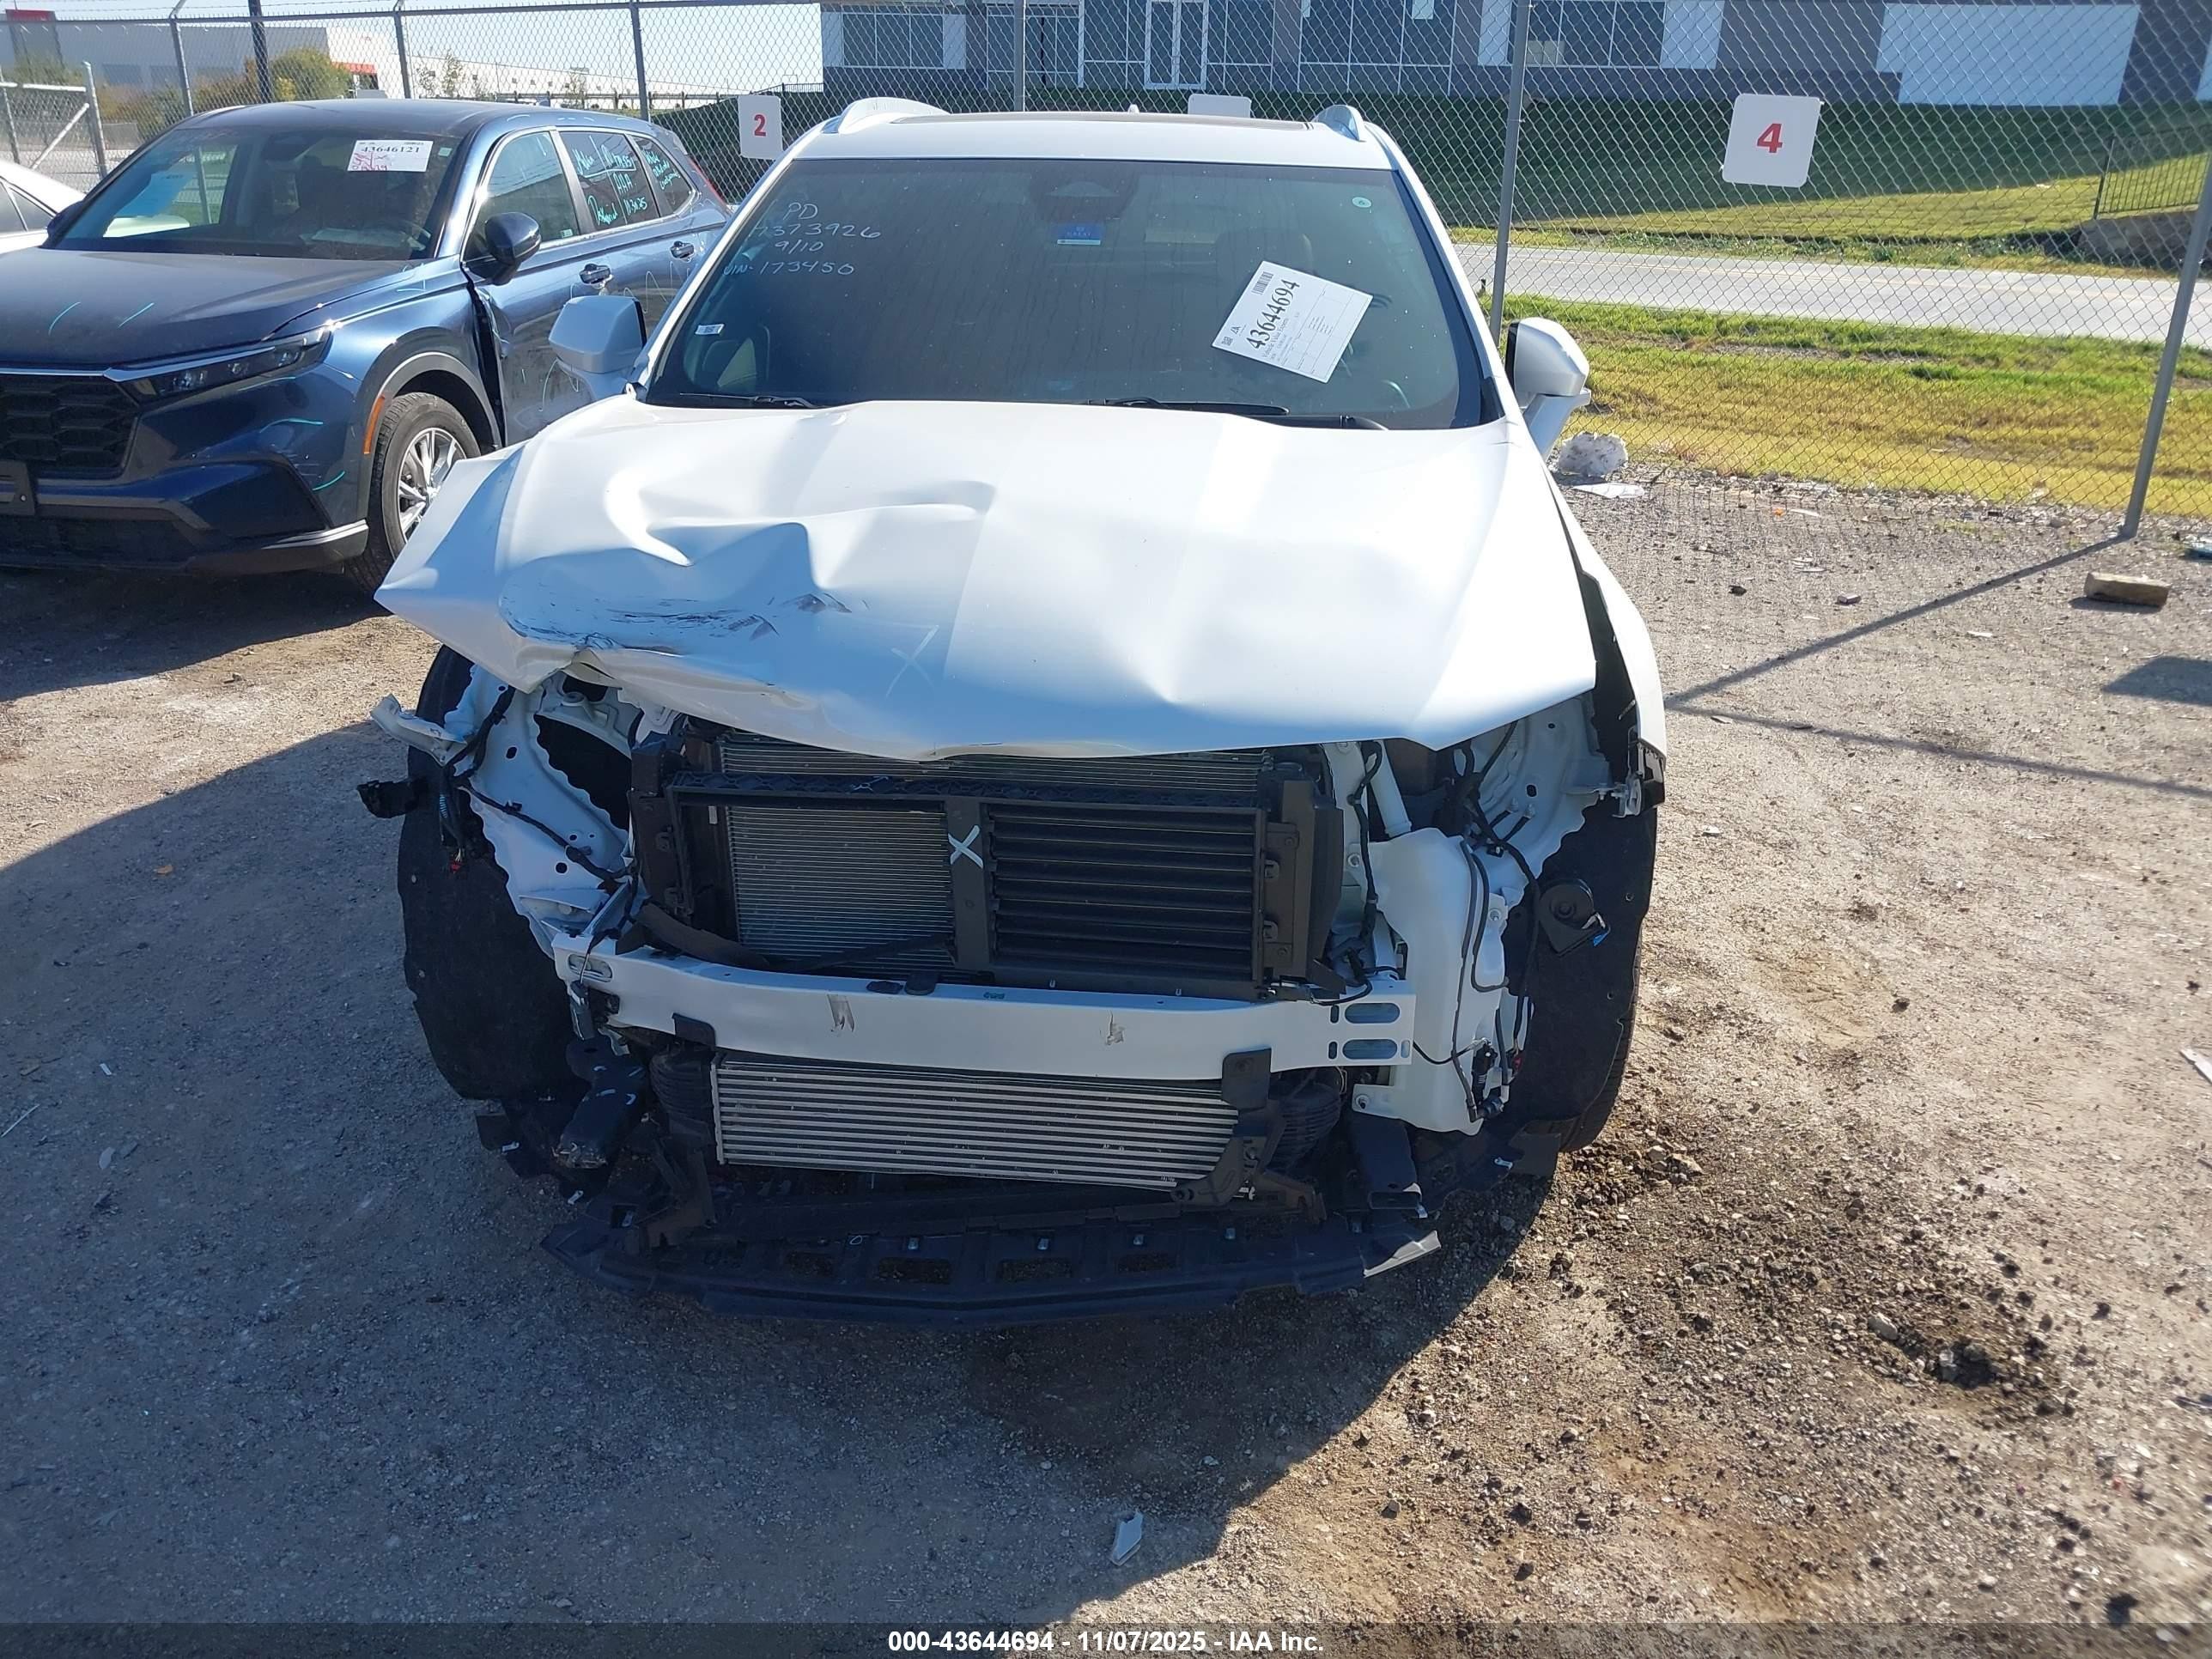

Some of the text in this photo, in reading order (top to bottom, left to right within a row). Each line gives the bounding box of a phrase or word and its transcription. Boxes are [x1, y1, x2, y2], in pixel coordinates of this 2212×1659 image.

[753, 114, 767, 137] 2
[1757, 123, 1783, 154] 4
[775, 239, 824, 254] 9/10
[1246, 279, 1301, 349] 43644694
